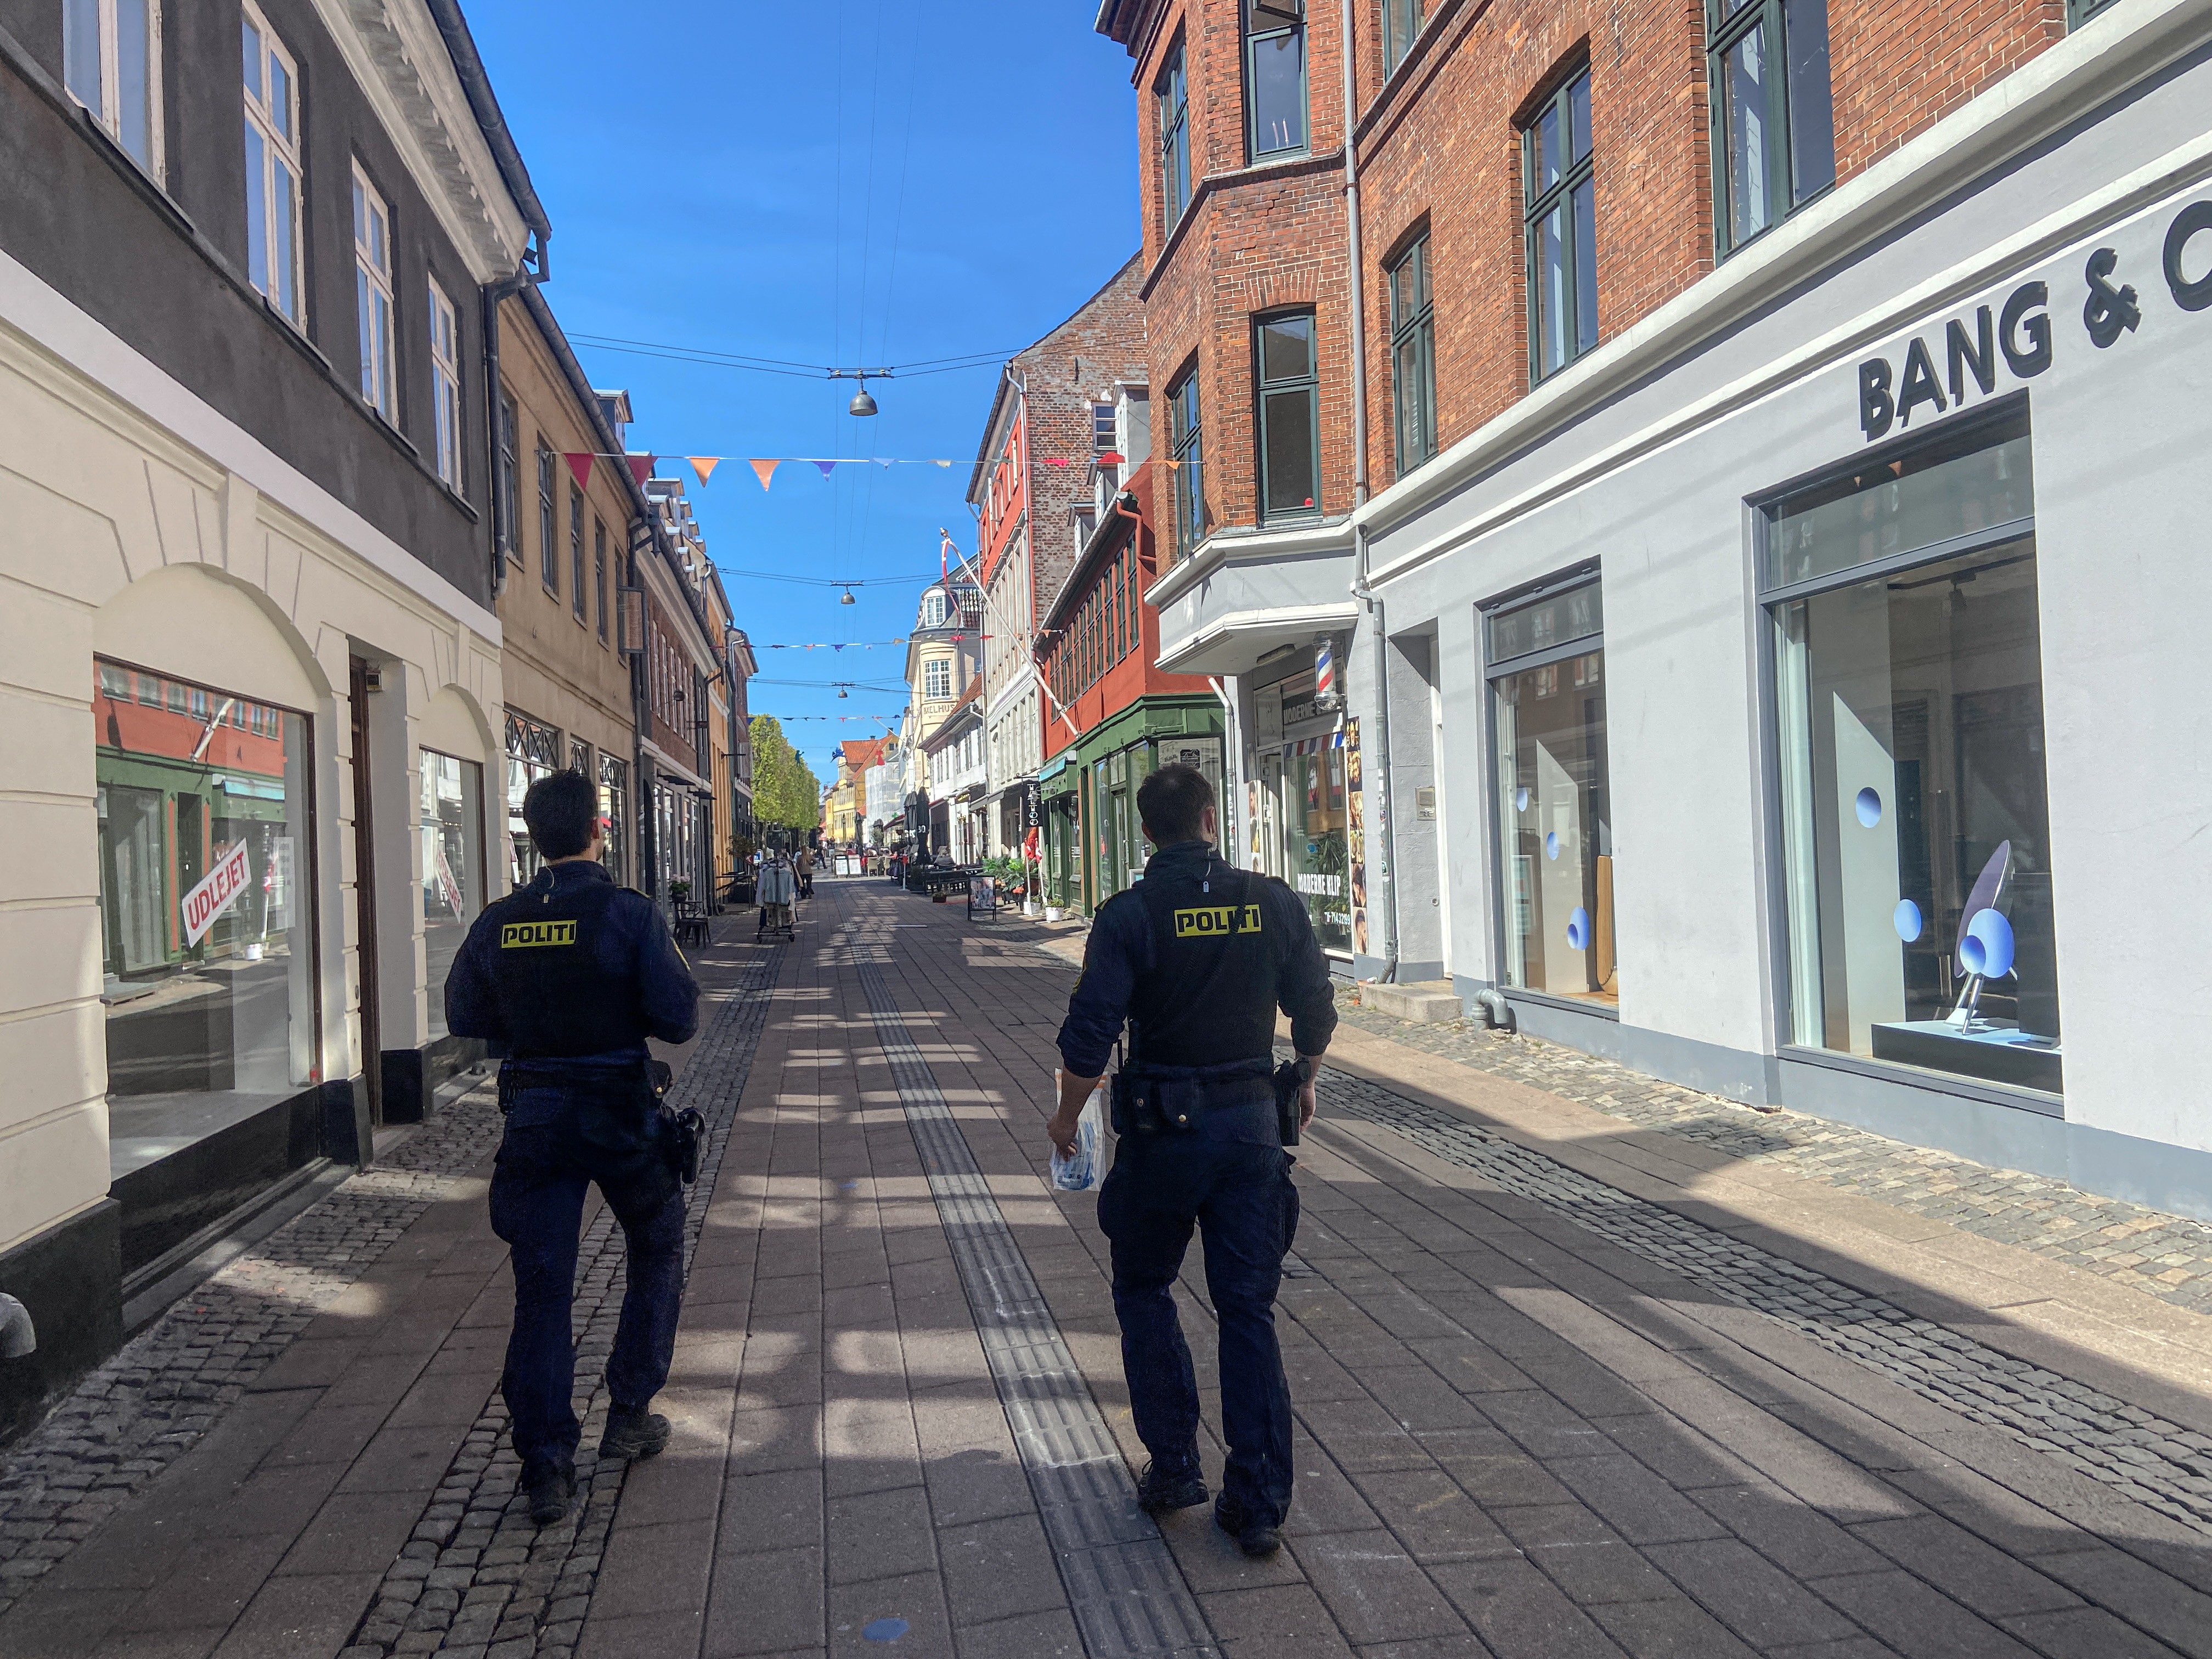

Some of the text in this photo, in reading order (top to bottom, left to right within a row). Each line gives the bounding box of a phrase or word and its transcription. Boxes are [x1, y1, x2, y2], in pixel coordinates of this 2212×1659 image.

[1859, 280, 2053, 443] BANG
[2084, 247, 2142, 349] &
[188, 851, 245, 930] UDLEJET
[1297, 873, 1341, 896] MODERNE KLIP
[503, 923, 575, 944] POLITI
